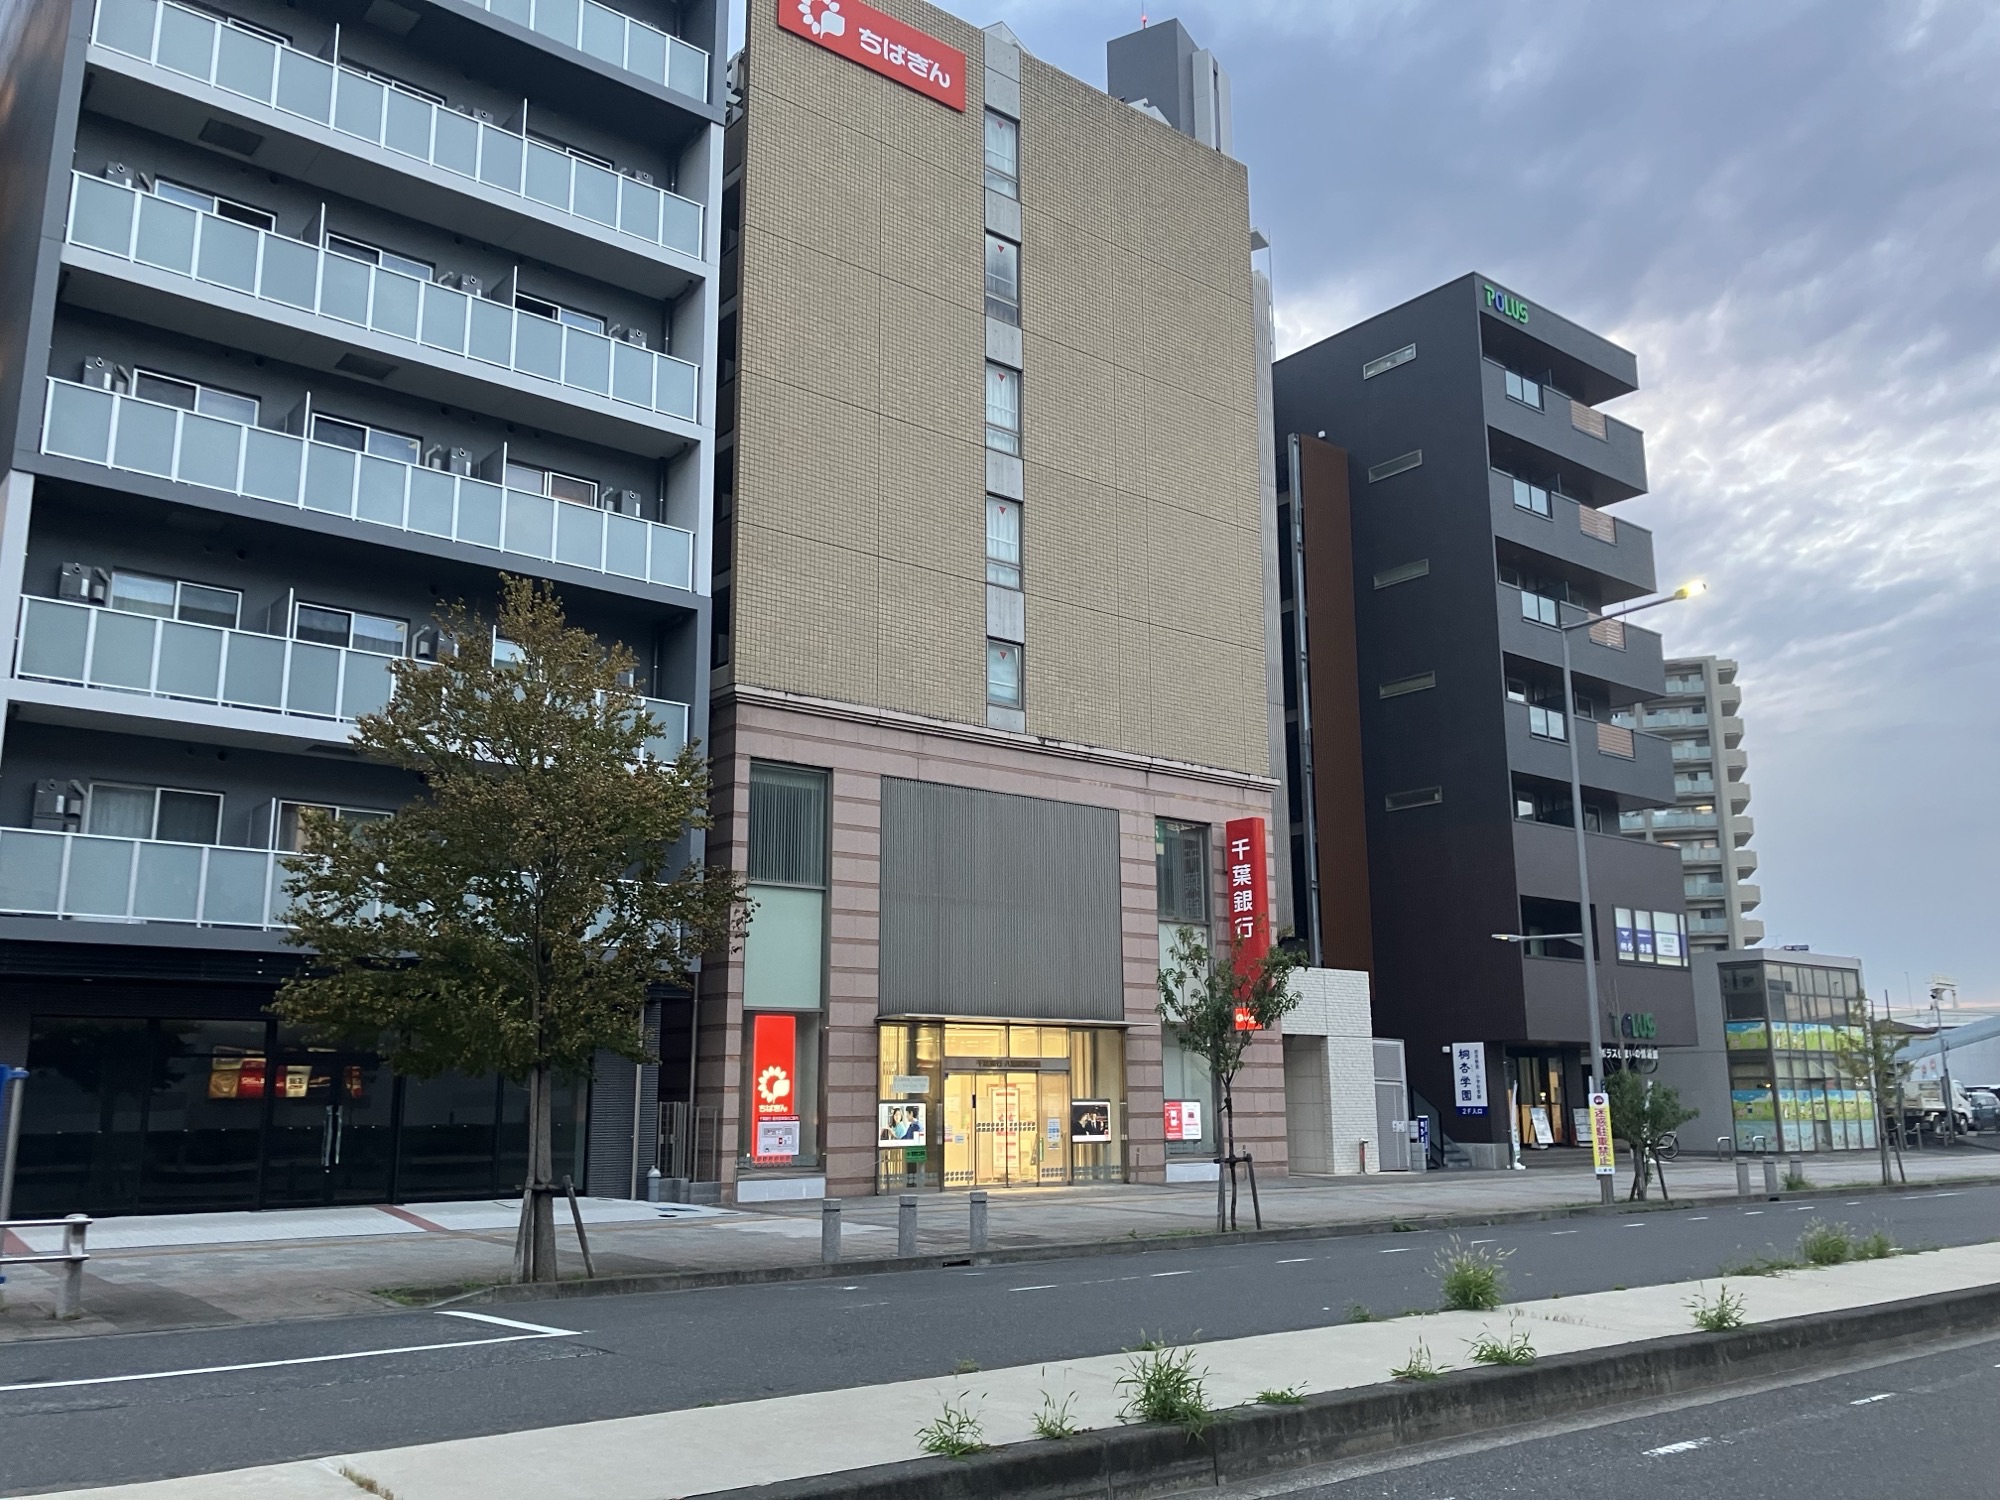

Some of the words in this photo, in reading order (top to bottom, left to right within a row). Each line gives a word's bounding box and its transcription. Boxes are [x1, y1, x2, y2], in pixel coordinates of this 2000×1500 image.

[858, 27, 951, 89] ちばぎん
[1484, 284, 1530, 325] POLUS
[1231, 838, 1254, 939] 千葉銀行
[1594, 1107, 1612, 1166] 迷惑駐車禁止
